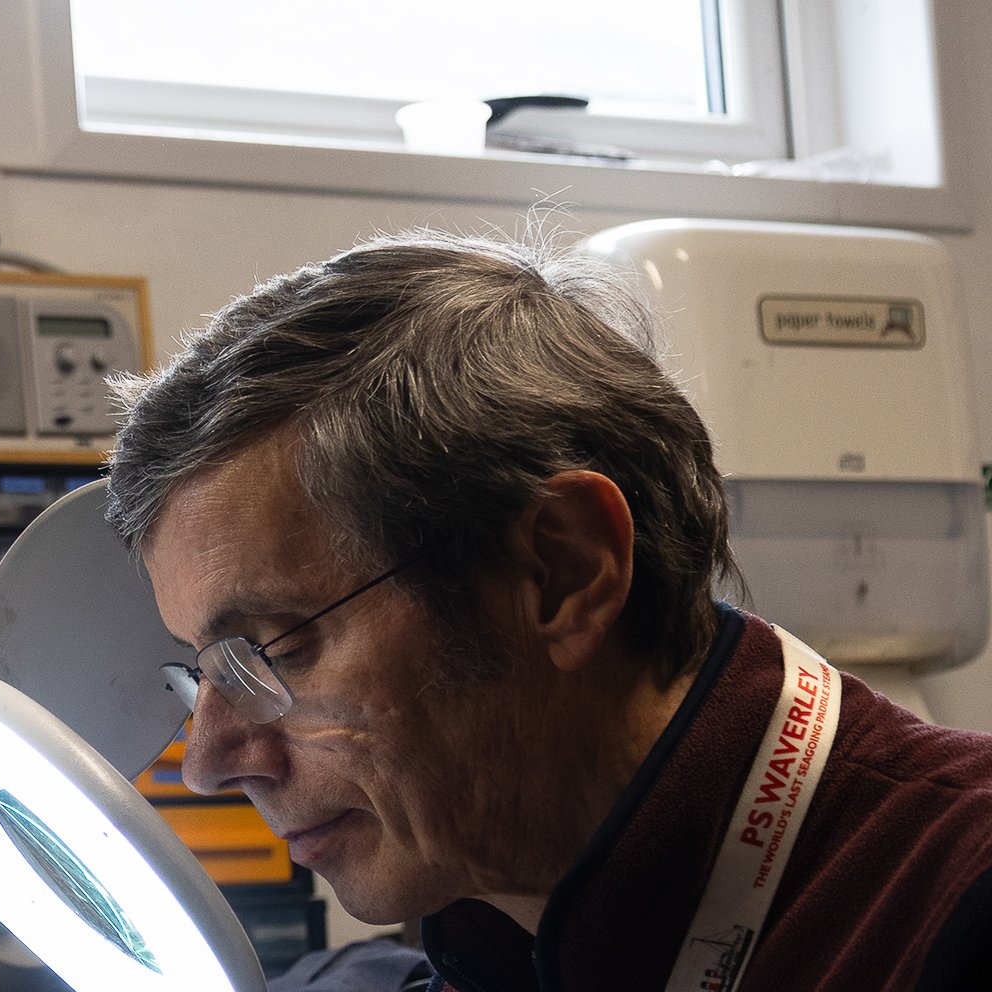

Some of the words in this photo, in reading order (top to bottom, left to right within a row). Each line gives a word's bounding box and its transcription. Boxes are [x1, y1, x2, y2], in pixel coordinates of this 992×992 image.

[753, 863, 771, 888] THE
[762, 808, 792, 864] WORLD'S
[788, 777, 804, 808] LAST
[797, 724, 823, 777] SEAGOING
[815, 689, 830, 723] PADDLE
[755, 666, 819, 804] WAVERLEY
[740, 809, 774, 847] PS
